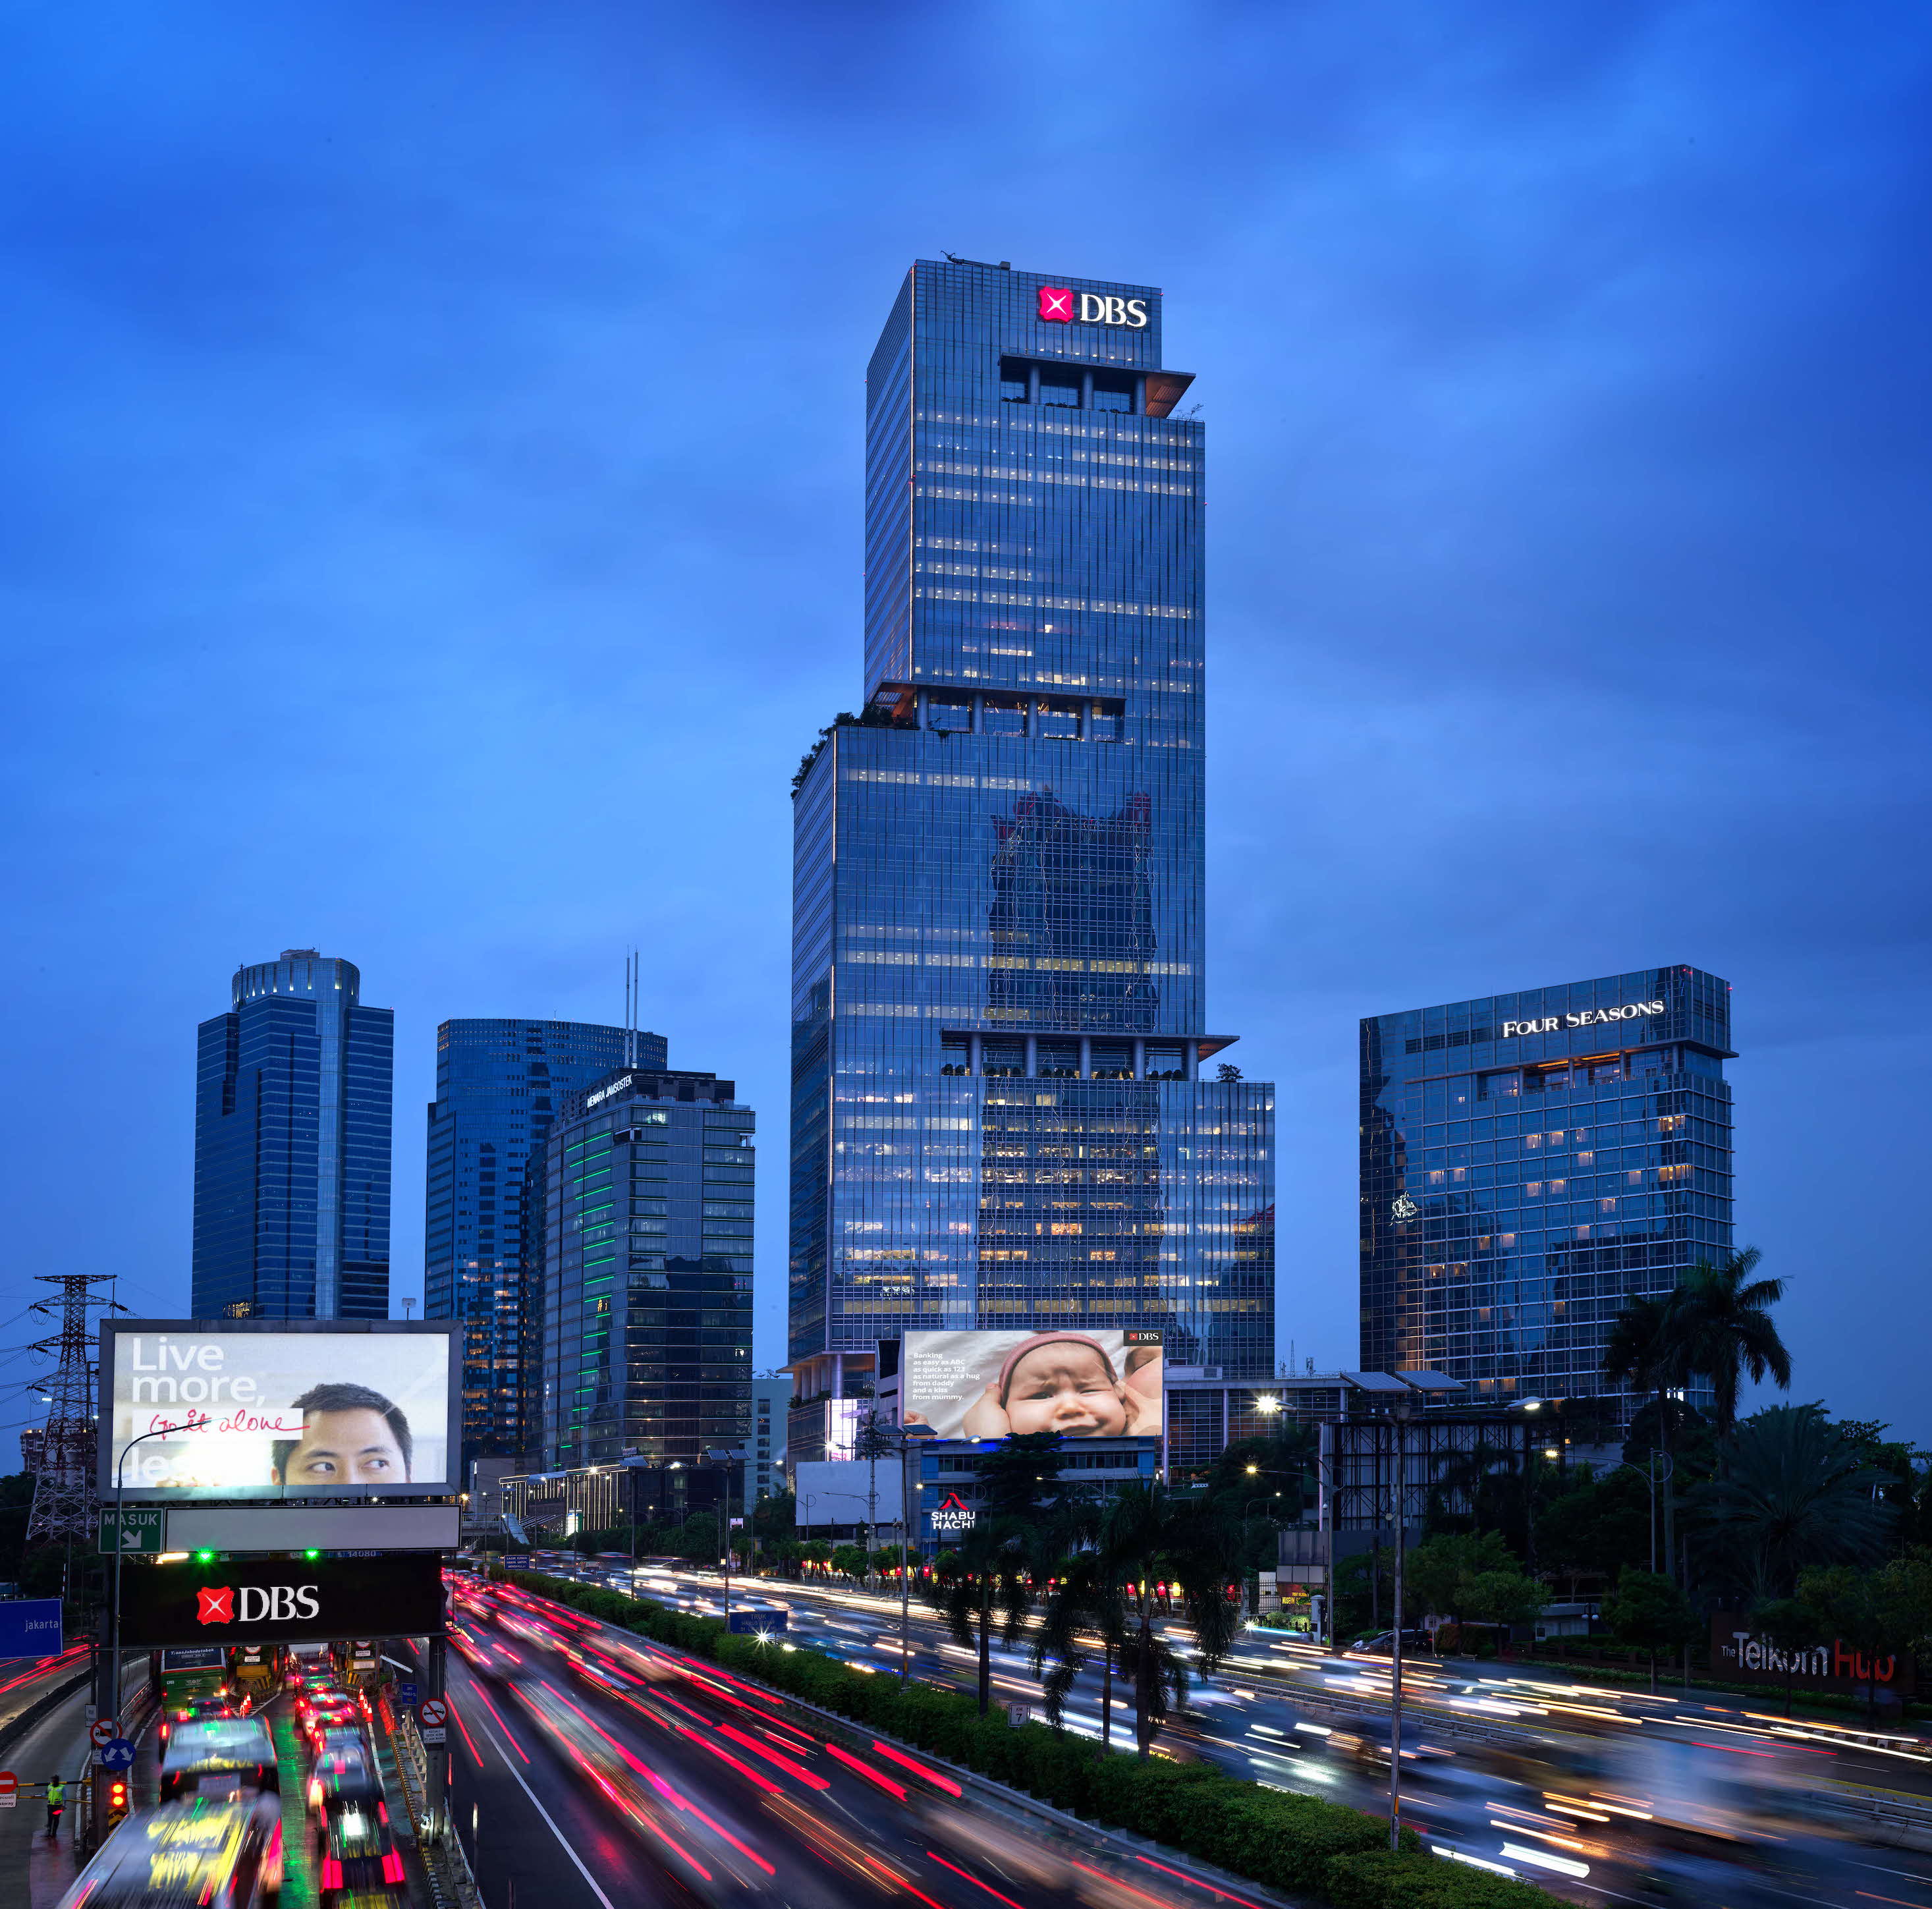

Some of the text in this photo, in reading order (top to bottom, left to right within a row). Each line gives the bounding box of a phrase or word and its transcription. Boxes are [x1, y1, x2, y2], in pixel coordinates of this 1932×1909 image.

[1080, 293, 1147, 327] DBS
[1503, 1000, 1664, 1038] FOUR SEASONS
[587, 1074, 632, 1109] MENARA JAMSOSTEK
[1138, 1332, 1159, 1341] DBS
[132, 1336, 225, 1371] Live
[132, 1375, 265, 1407] more,
[182, 1409, 212, 1433] it
[219, 1409, 310, 1431] alone
[104, 1513, 157, 1526] MASUK
[931, 1512, 975, 1520] SHABU
[933, 1520, 974, 1529] HACHI
[238, 1585, 319, 1622] DBS
[24, 1620, 59, 1632] jakarta
[1721, 1646, 1736, 1657] The
[1016, 1713, 1022, 1723] 7
